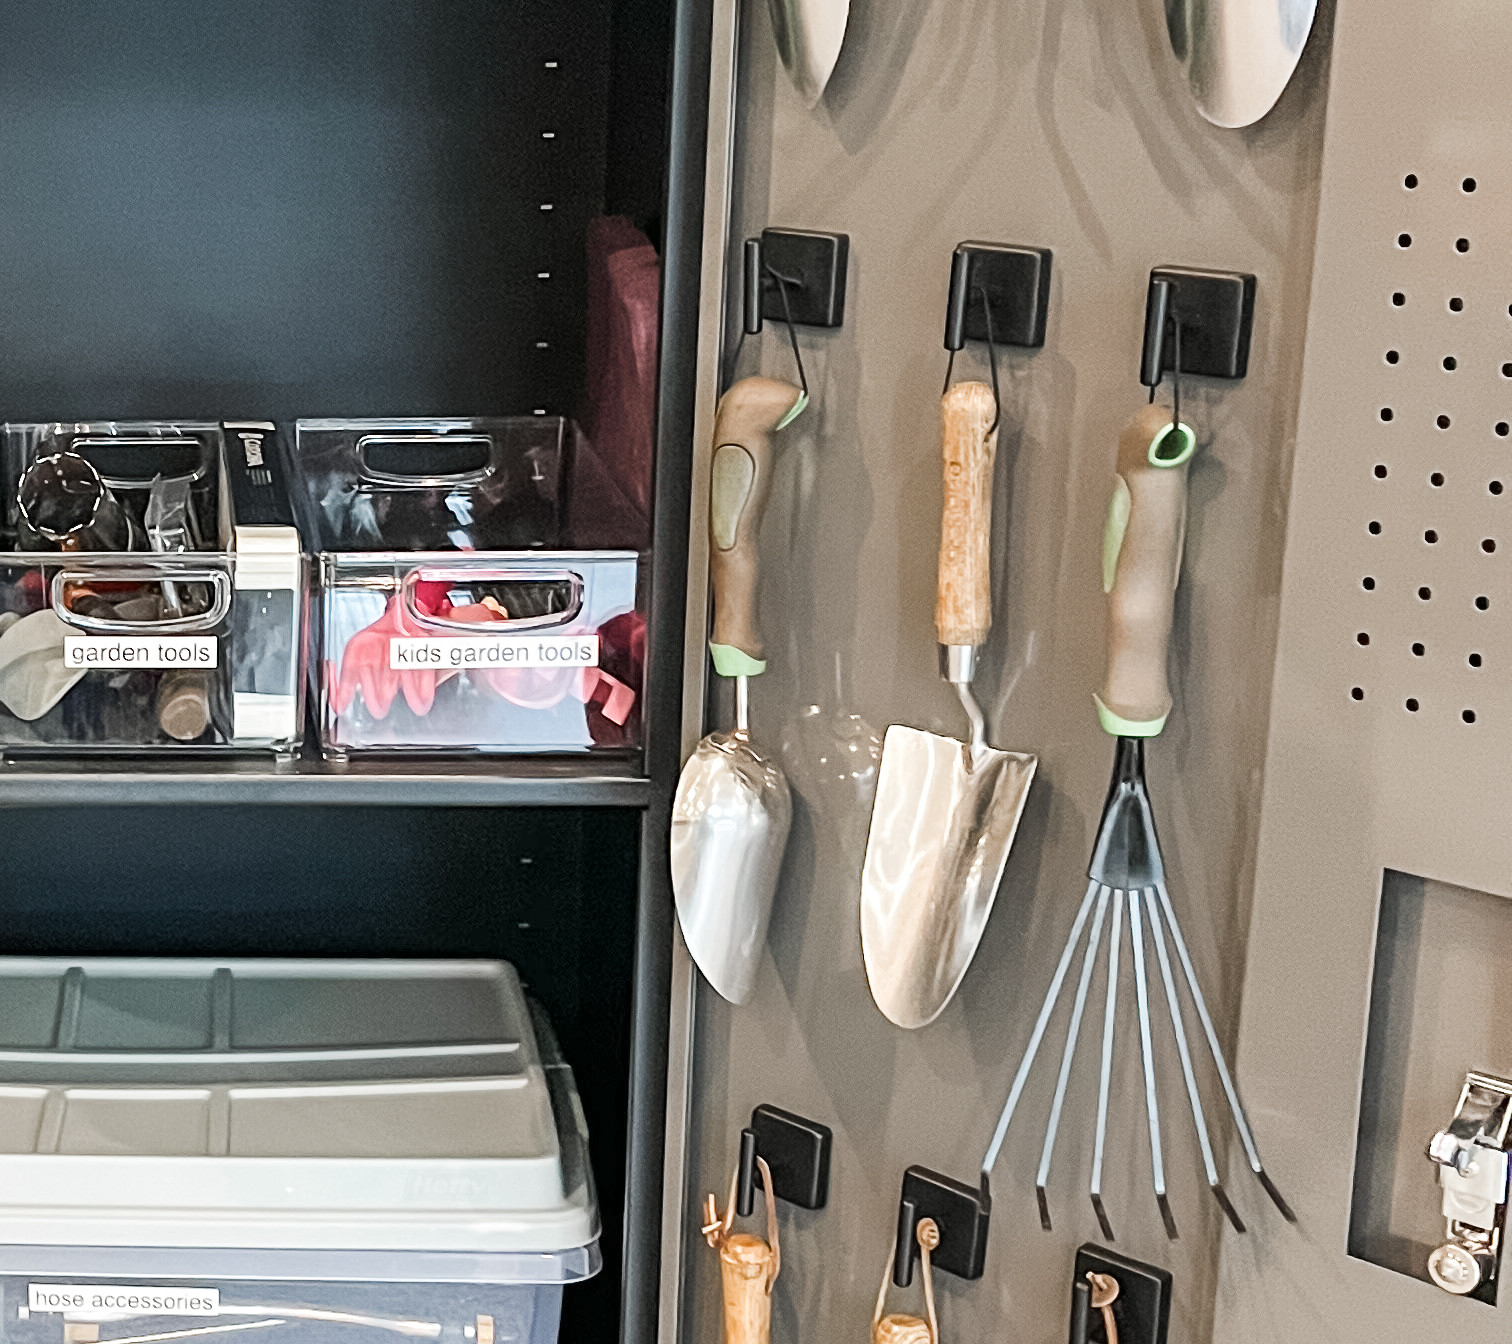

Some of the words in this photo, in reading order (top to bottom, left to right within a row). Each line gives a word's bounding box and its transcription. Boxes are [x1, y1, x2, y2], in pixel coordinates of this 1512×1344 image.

[72, 643, 149, 664] garden
[158, 643, 210, 662] tools
[397, 644, 441, 662] kids
[450, 643, 529, 665] garden
[538, 642, 592, 661] tools
[36, 1290, 84, 1306] hose
[92, 1294, 213, 1310] accessories
